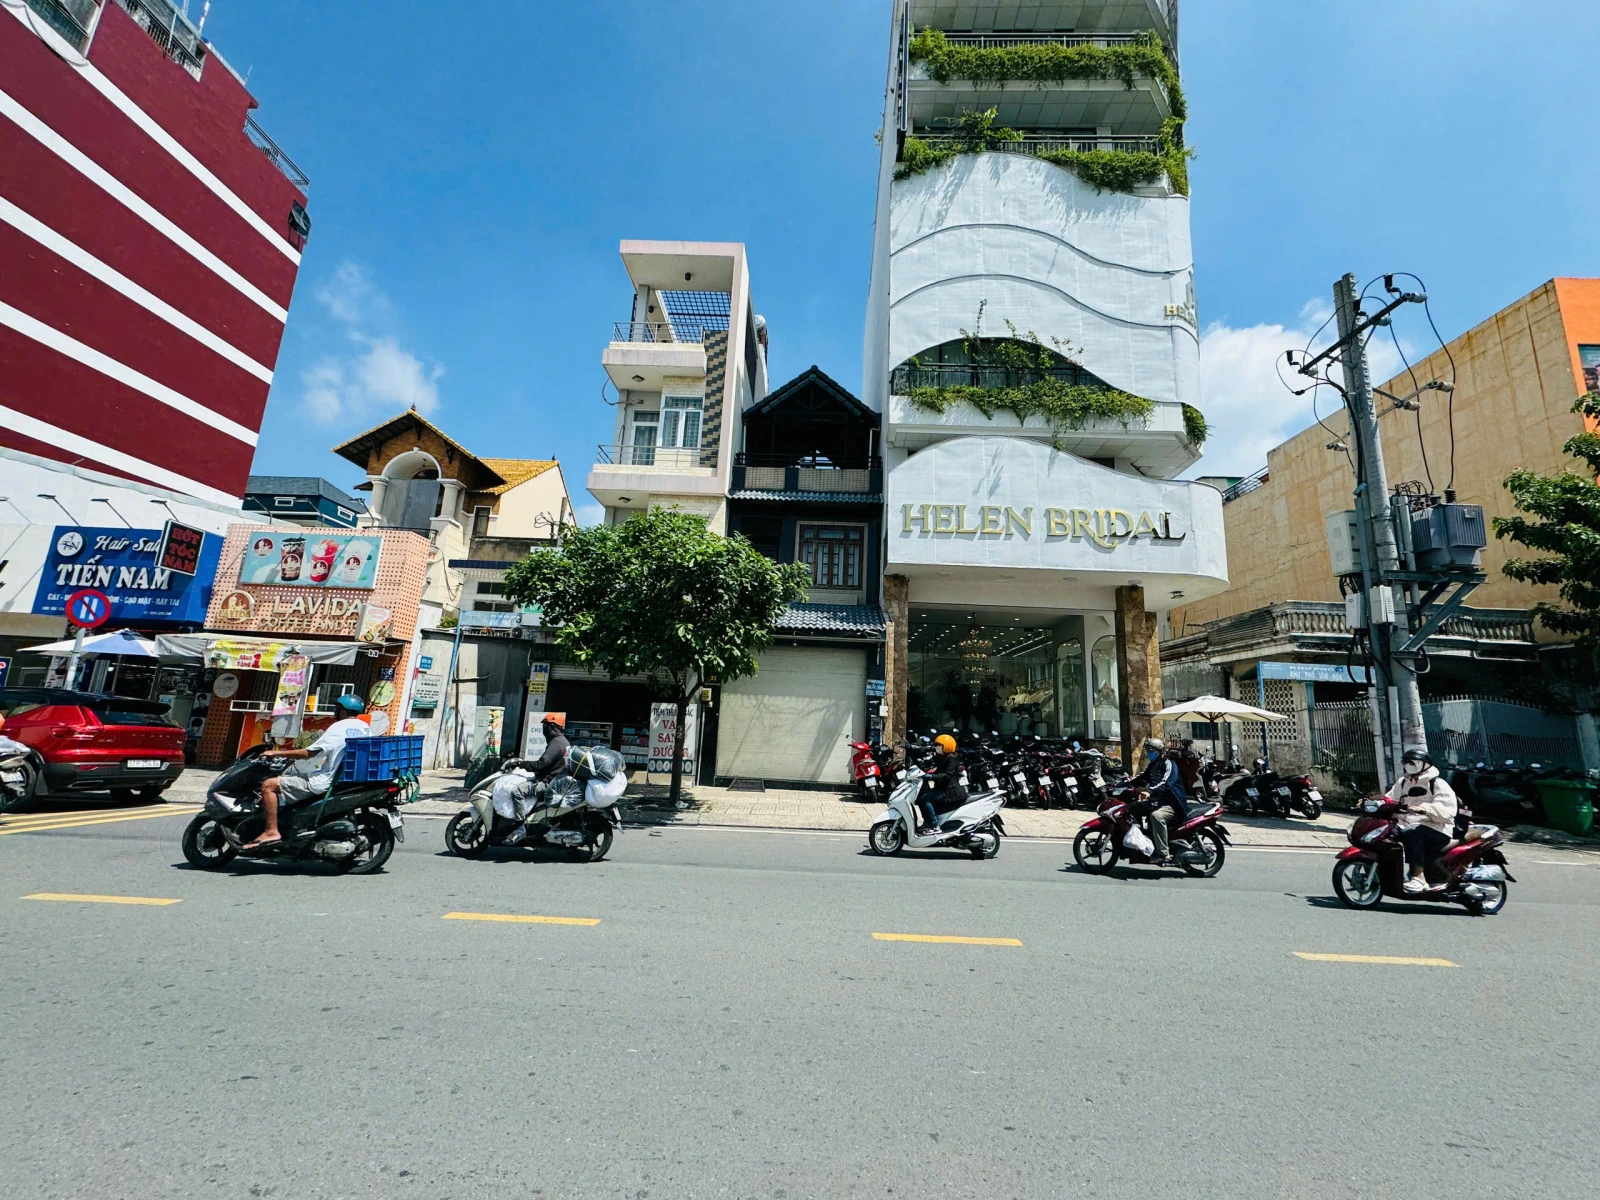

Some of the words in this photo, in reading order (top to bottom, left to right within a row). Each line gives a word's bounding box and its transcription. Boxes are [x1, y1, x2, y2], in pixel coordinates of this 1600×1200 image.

[902, 504, 1033, 535] HELEN
[1046, 508, 1186, 548] BRIDAL
[93, 535, 133, 551] Hair
[171, 527, 201, 545] HỚT
[169, 542, 196, 559] TÓC
[163, 554, 195, 572] NAM
[56, 555, 114, 588] TIẾN
[116, 566, 171, 590] NAM
[272, 595, 363, 617] LAVIDA
[258, 617, 312, 629] COFFEE
[315, 618, 345, 631] AND
[380, 667, 394, 676] 136
[662, 719, 677, 731] VẠ
[653, 745, 689, 758] ĐƯỜG
